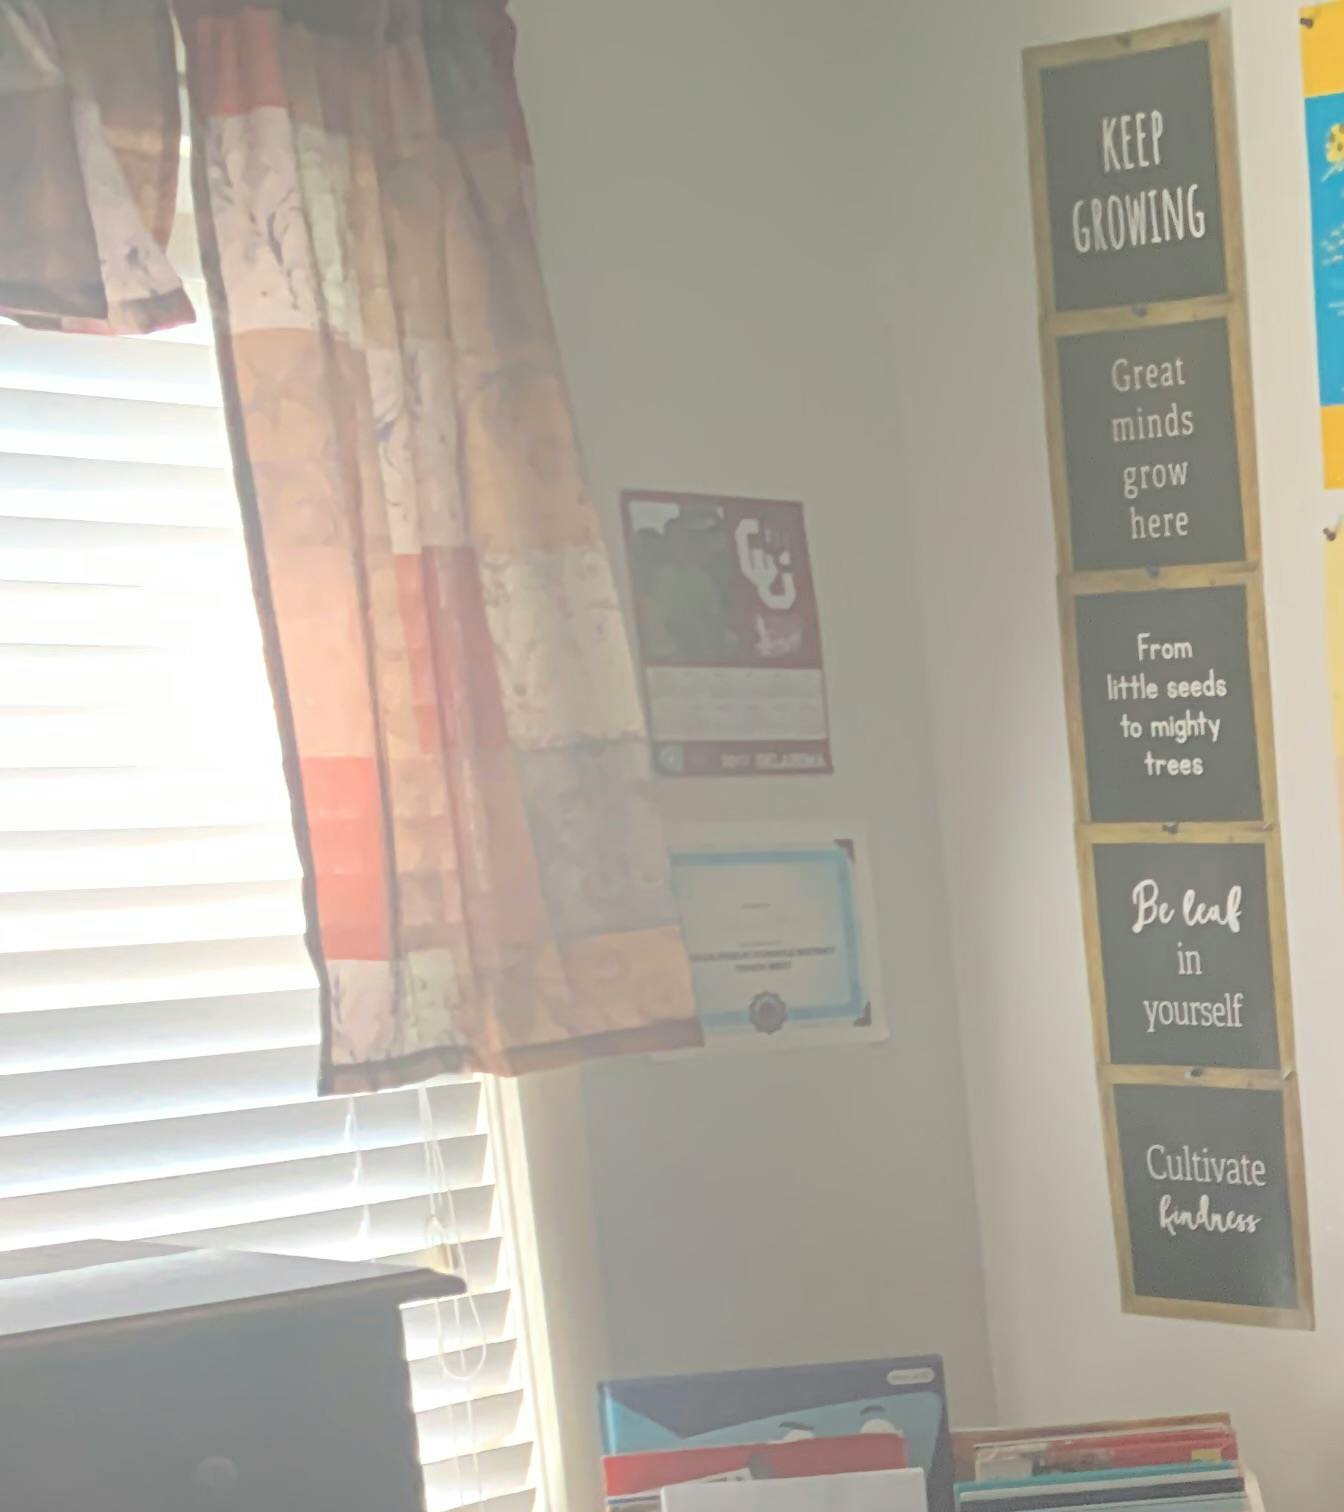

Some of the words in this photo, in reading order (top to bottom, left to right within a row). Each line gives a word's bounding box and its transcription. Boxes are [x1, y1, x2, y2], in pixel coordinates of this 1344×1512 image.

[1101, 110, 1165, 172] KEEP
[1072, 184, 1207, 253] GROWING
[1111, 356, 1186, 393] Great
[1111, 404, 1194, 444] minds
[1123, 460, 1189, 500] grow
[1130, 507, 1190, 541] here
[1136, 633, 1193, 661] From
[1107, 673, 1159, 701] little
[1166, 670, 1227, 699] seeds
[1121, 713, 1143, 738] to
[1150, 712, 1221, 745] mighty
[1145, 750, 1205, 777] trees
[1131, 878, 1176, 933] Be
[1182, 882, 1243, 933] leaf
[1177, 943, 1202, 975] in
[1143, 991, 1245, 1032] yourself
[1146, 1144, 1267, 1188] Cultivate
[1158, 1193, 1261, 1236] kindness
